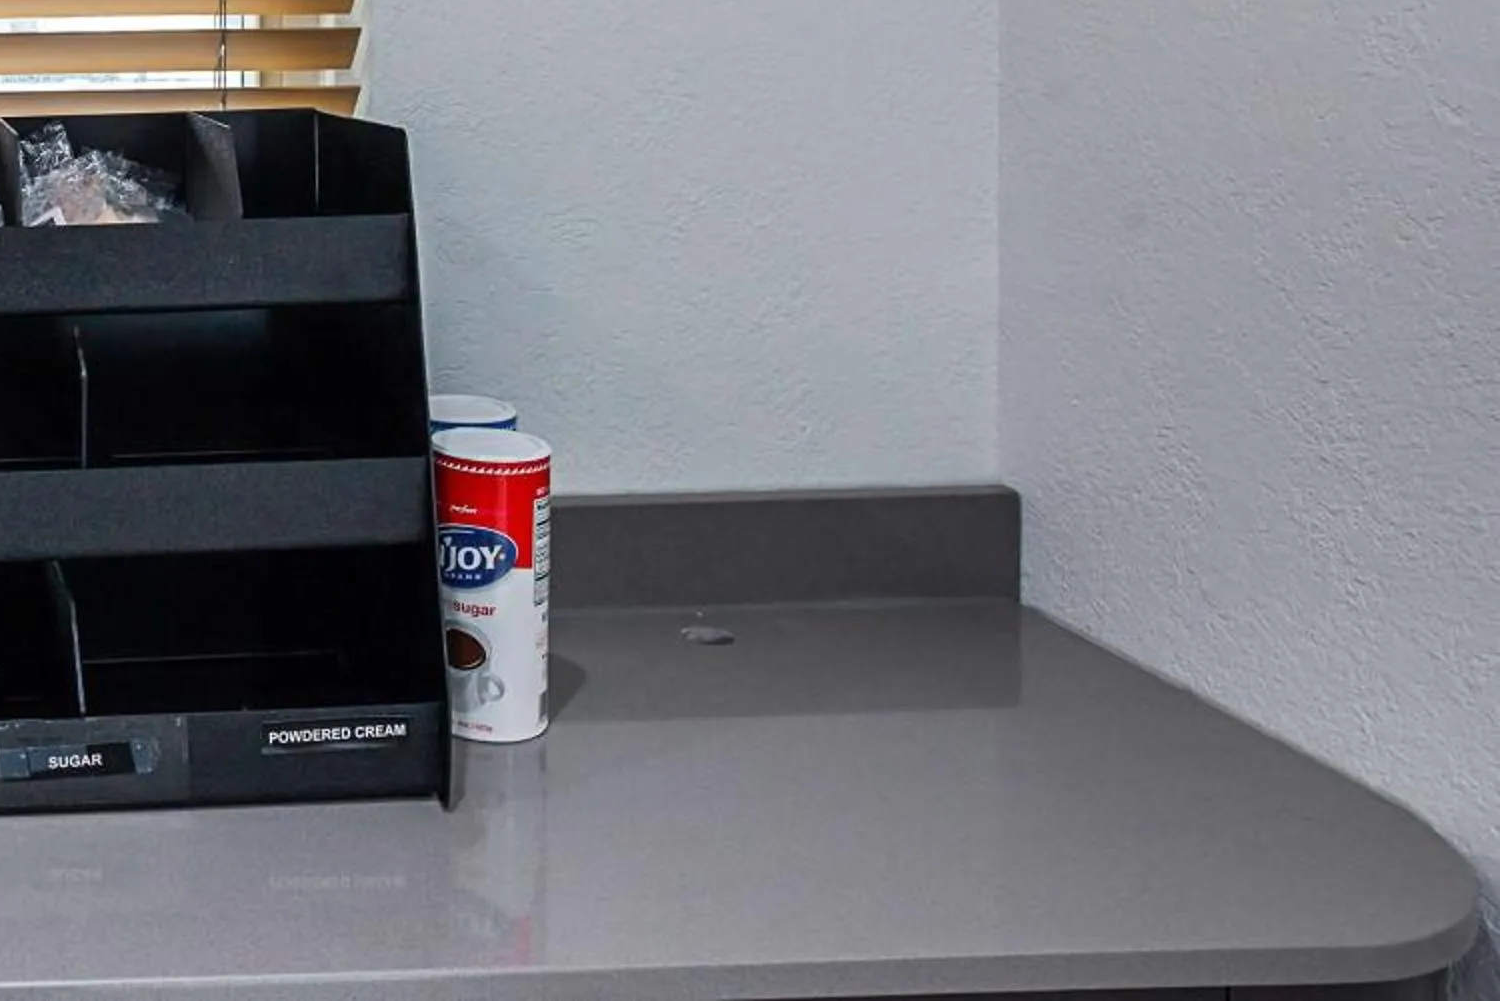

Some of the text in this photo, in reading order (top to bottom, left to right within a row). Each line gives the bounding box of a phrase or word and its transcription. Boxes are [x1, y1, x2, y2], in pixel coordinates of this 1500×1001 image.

[452, 599, 498, 618] sugar
[267, 723, 407, 745] POWDERED CREAM
[47, 752, 103, 770] SUGAR
